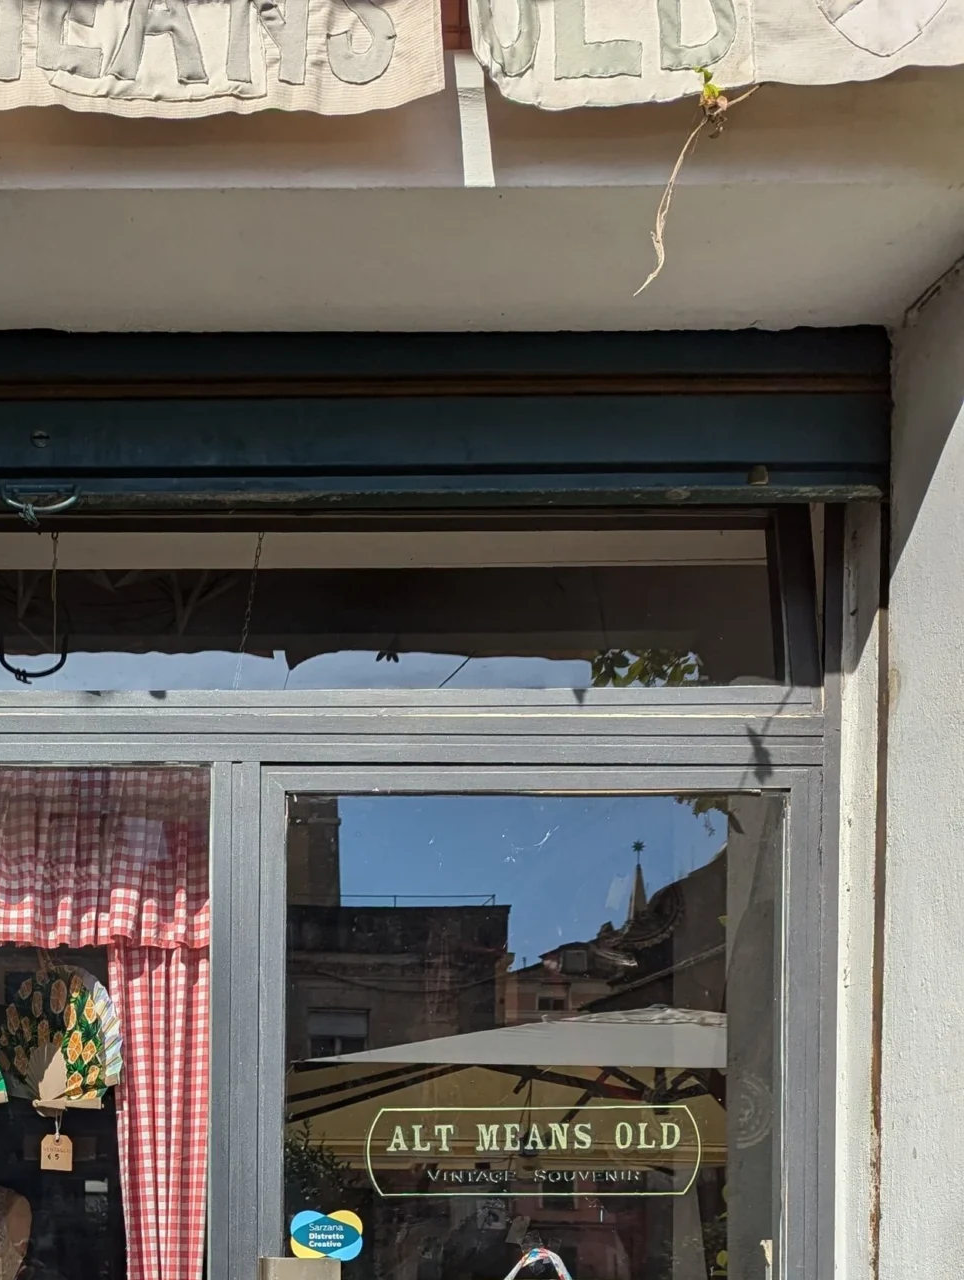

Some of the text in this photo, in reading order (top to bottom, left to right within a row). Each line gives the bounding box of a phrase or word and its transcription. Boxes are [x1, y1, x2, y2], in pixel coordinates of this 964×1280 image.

[386, 1121, 681, 1152] ALT MEANS OLD
[426, 1168, 517, 1184] VINTAGE
[308, 1223, 344, 1232] Sarzana
